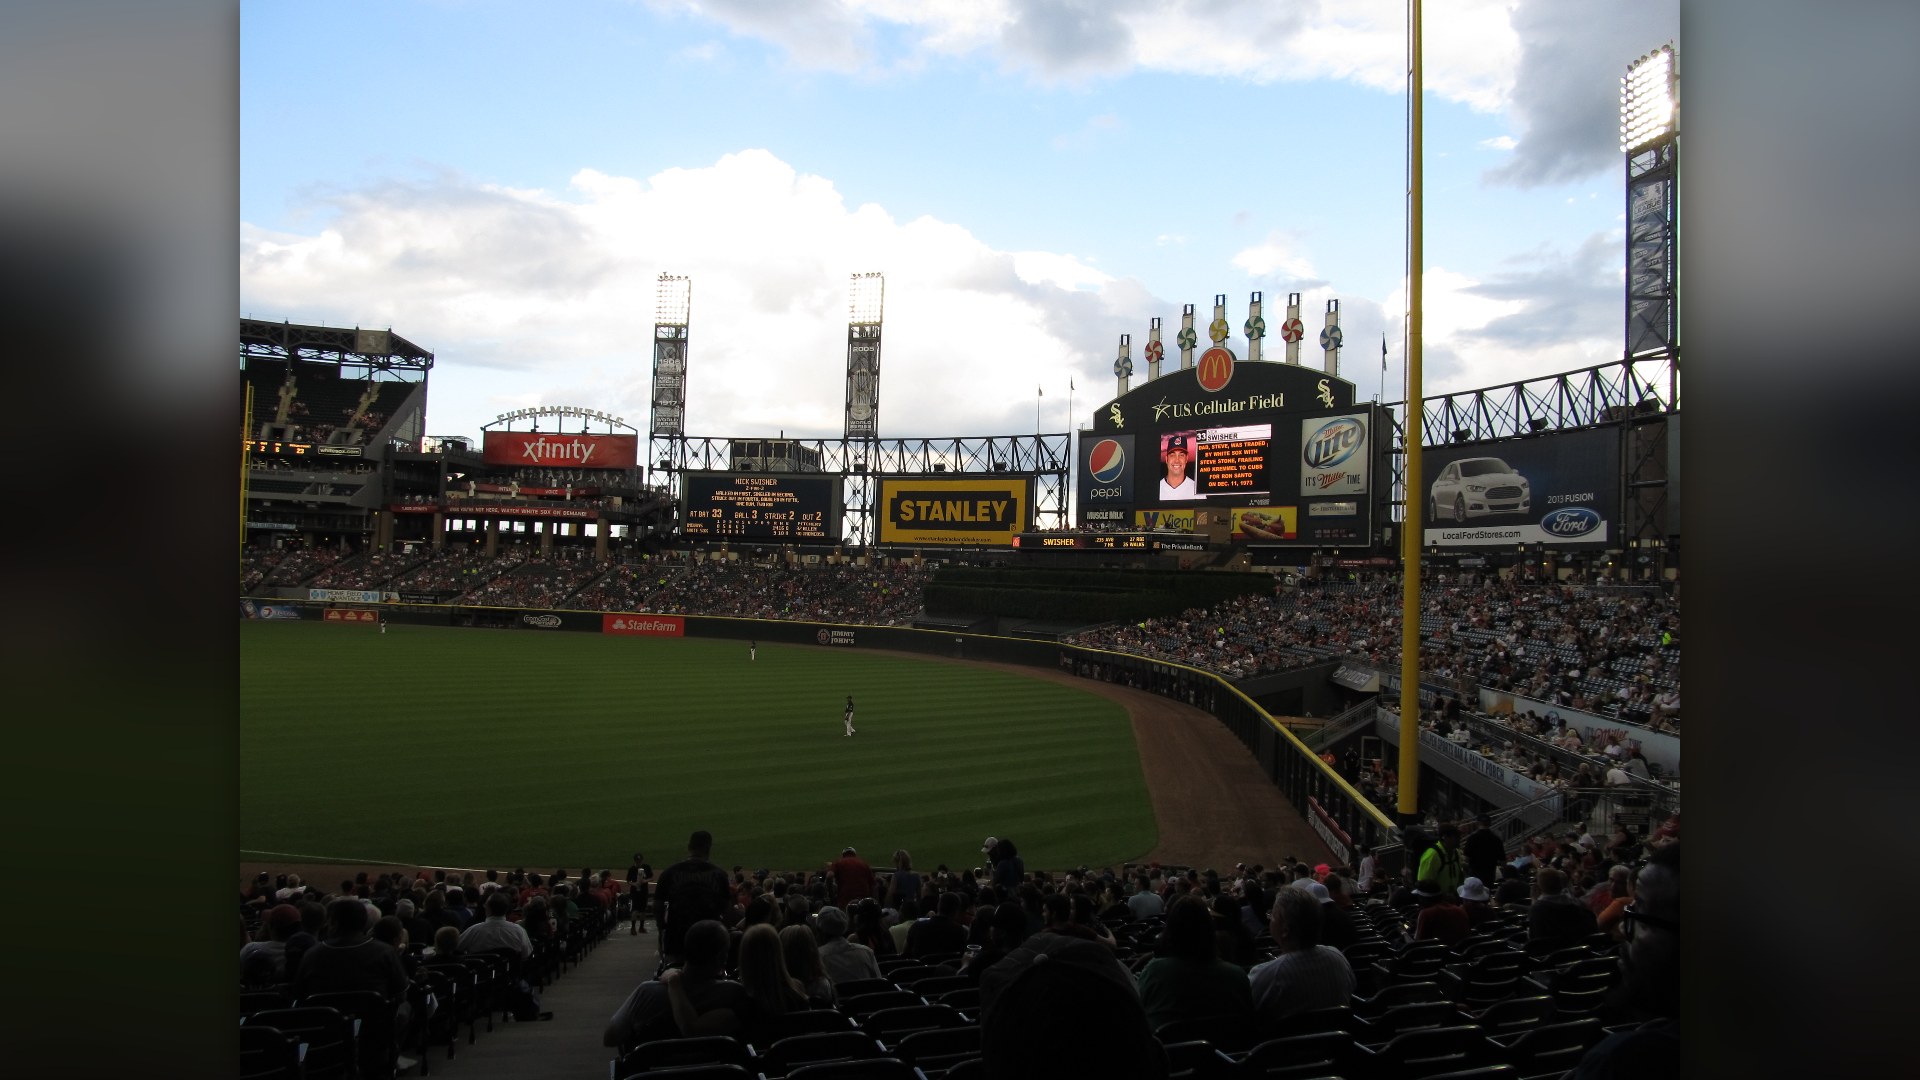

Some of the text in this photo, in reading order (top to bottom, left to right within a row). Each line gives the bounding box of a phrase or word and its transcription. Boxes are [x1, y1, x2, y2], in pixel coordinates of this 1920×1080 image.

[1173, 393, 1284, 418] U.S. Cellular Field
[497, 406, 624, 429] FUNDAMENTALS
[1207, 433, 1238, 441] SWISHER
[1323, 424, 1345, 439] Miller
[522, 438, 596, 464] xfinity
[1311, 426, 1357, 469] Lite
[1305, 471, 1361, 490] IT'S Miller TIME
[1090, 485, 1122, 500] pepsi
[1547, 493, 1594, 504] 2013 FUSION
[711, 509, 723, 518] 33
[734, 510, 758, 519] BALL 3
[789, 511, 795, 520] 2
[815, 512, 821, 520] 2
[900, 500, 1007, 522] STANLEY
[1086, 511, 1124, 520] MUSCLE MILK
[1552, 512, 1589, 532] Ford
[1442, 530, 1521, 540] LocalFordStores.com
[1043, 538, 1075, 546] SWISHER
[831, 637, 855, 645] JOHN'S
[1469, 752, 1485, 773] PARTY
[1485, 759, 1504, 782] PORCH
